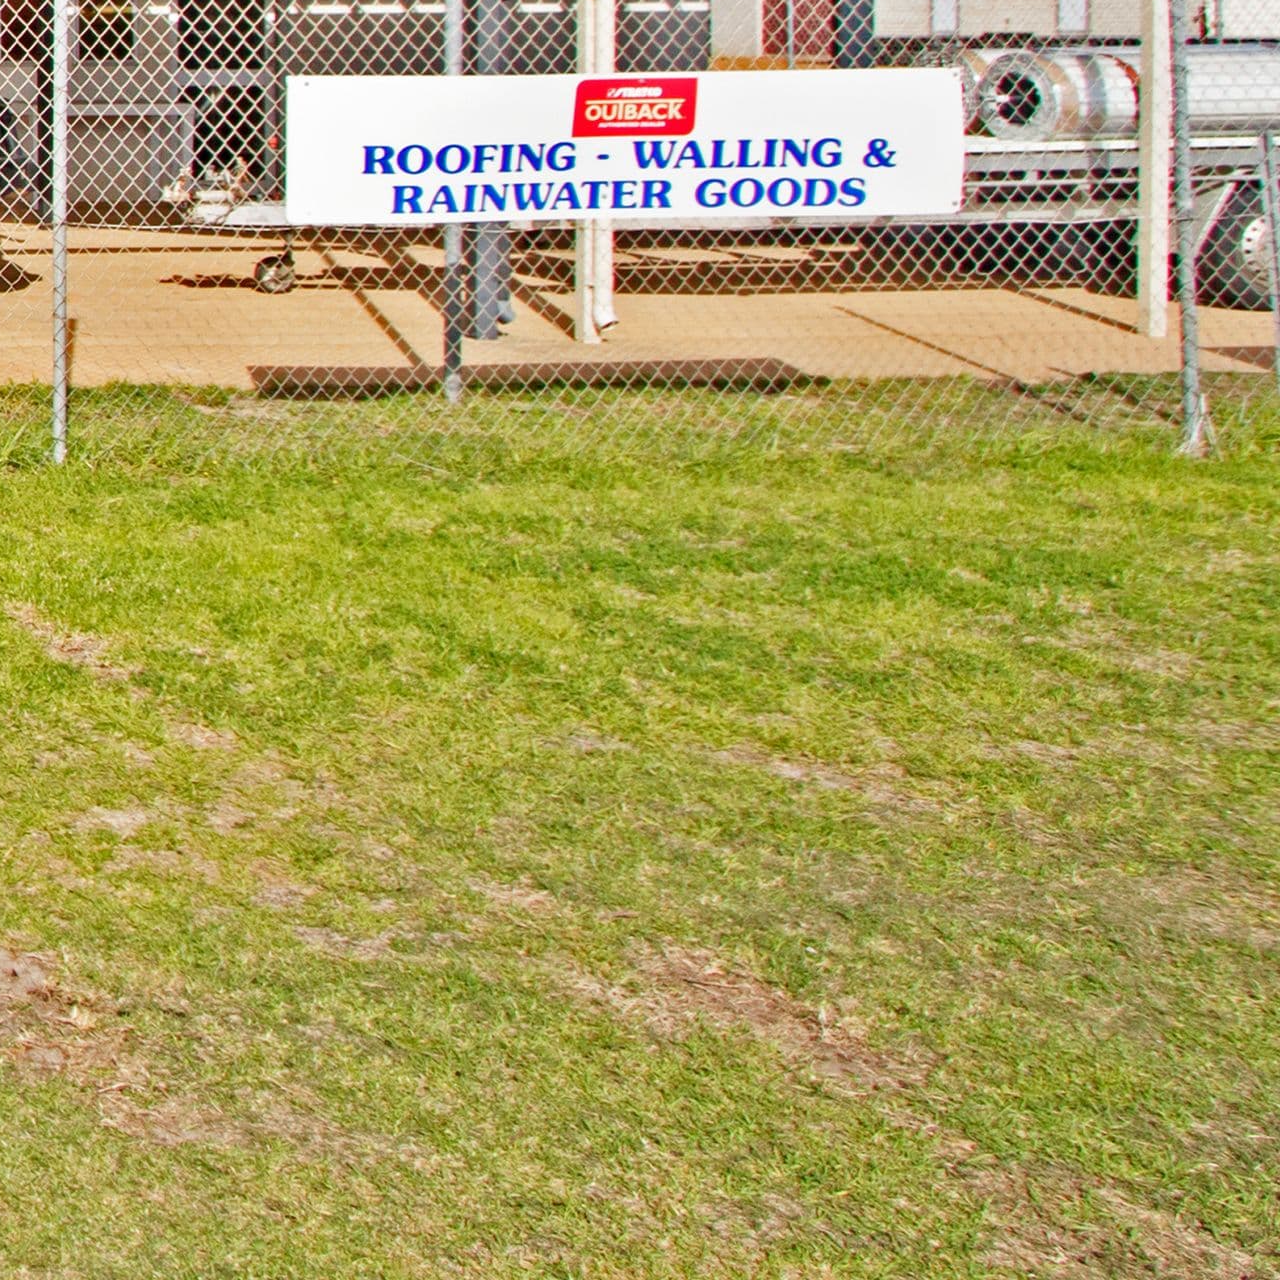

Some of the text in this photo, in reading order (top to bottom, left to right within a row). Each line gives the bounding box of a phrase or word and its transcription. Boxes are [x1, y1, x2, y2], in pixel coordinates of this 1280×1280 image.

[585, 99, 686, 121] OUTBACK
[363, 141, 578, 175] ROOFING
[634, 137, 843, 170] WALLING
[864, 137, 898, 169] &
[392, 177, 868, 215] RAINWATER GOODS
